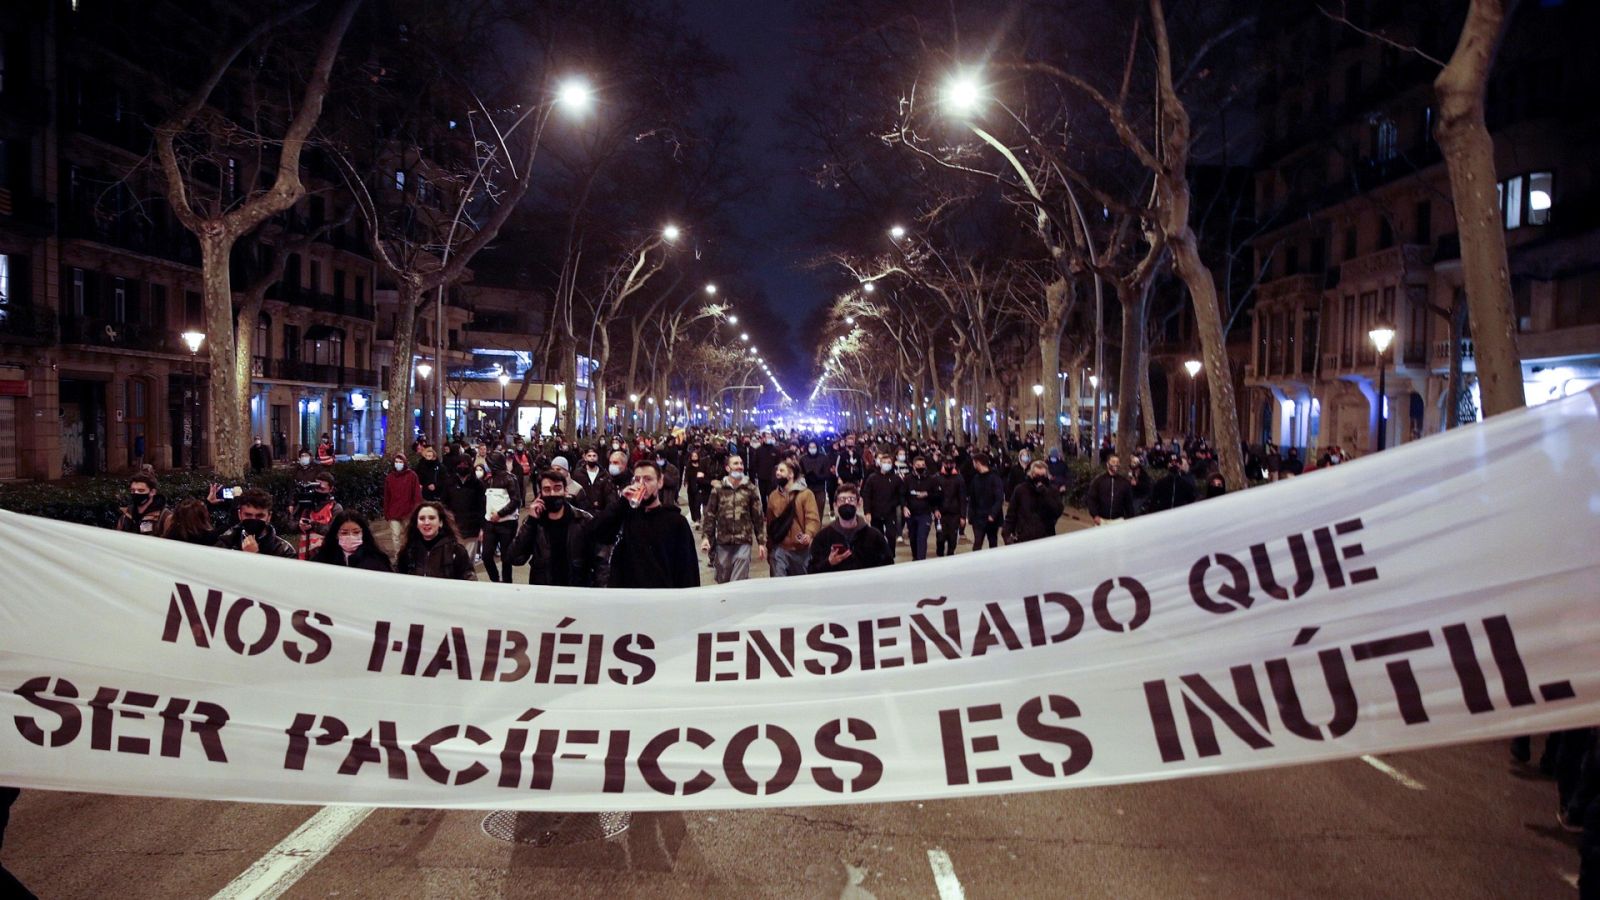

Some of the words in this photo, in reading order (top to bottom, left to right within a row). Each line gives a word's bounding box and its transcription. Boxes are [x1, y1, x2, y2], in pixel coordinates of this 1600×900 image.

[162, 582, 333, 665] NOS
[366, 616, 656, 686] HABÉIS
[694, 576, 1152, 683] ENSEÑADO
[1188, 517, 1379, 615] QUE
[13, 675, 231, 764] SER
[283, 707, 884, 796] PACÍFICOS
[938, 694, 1094, 786] ES
